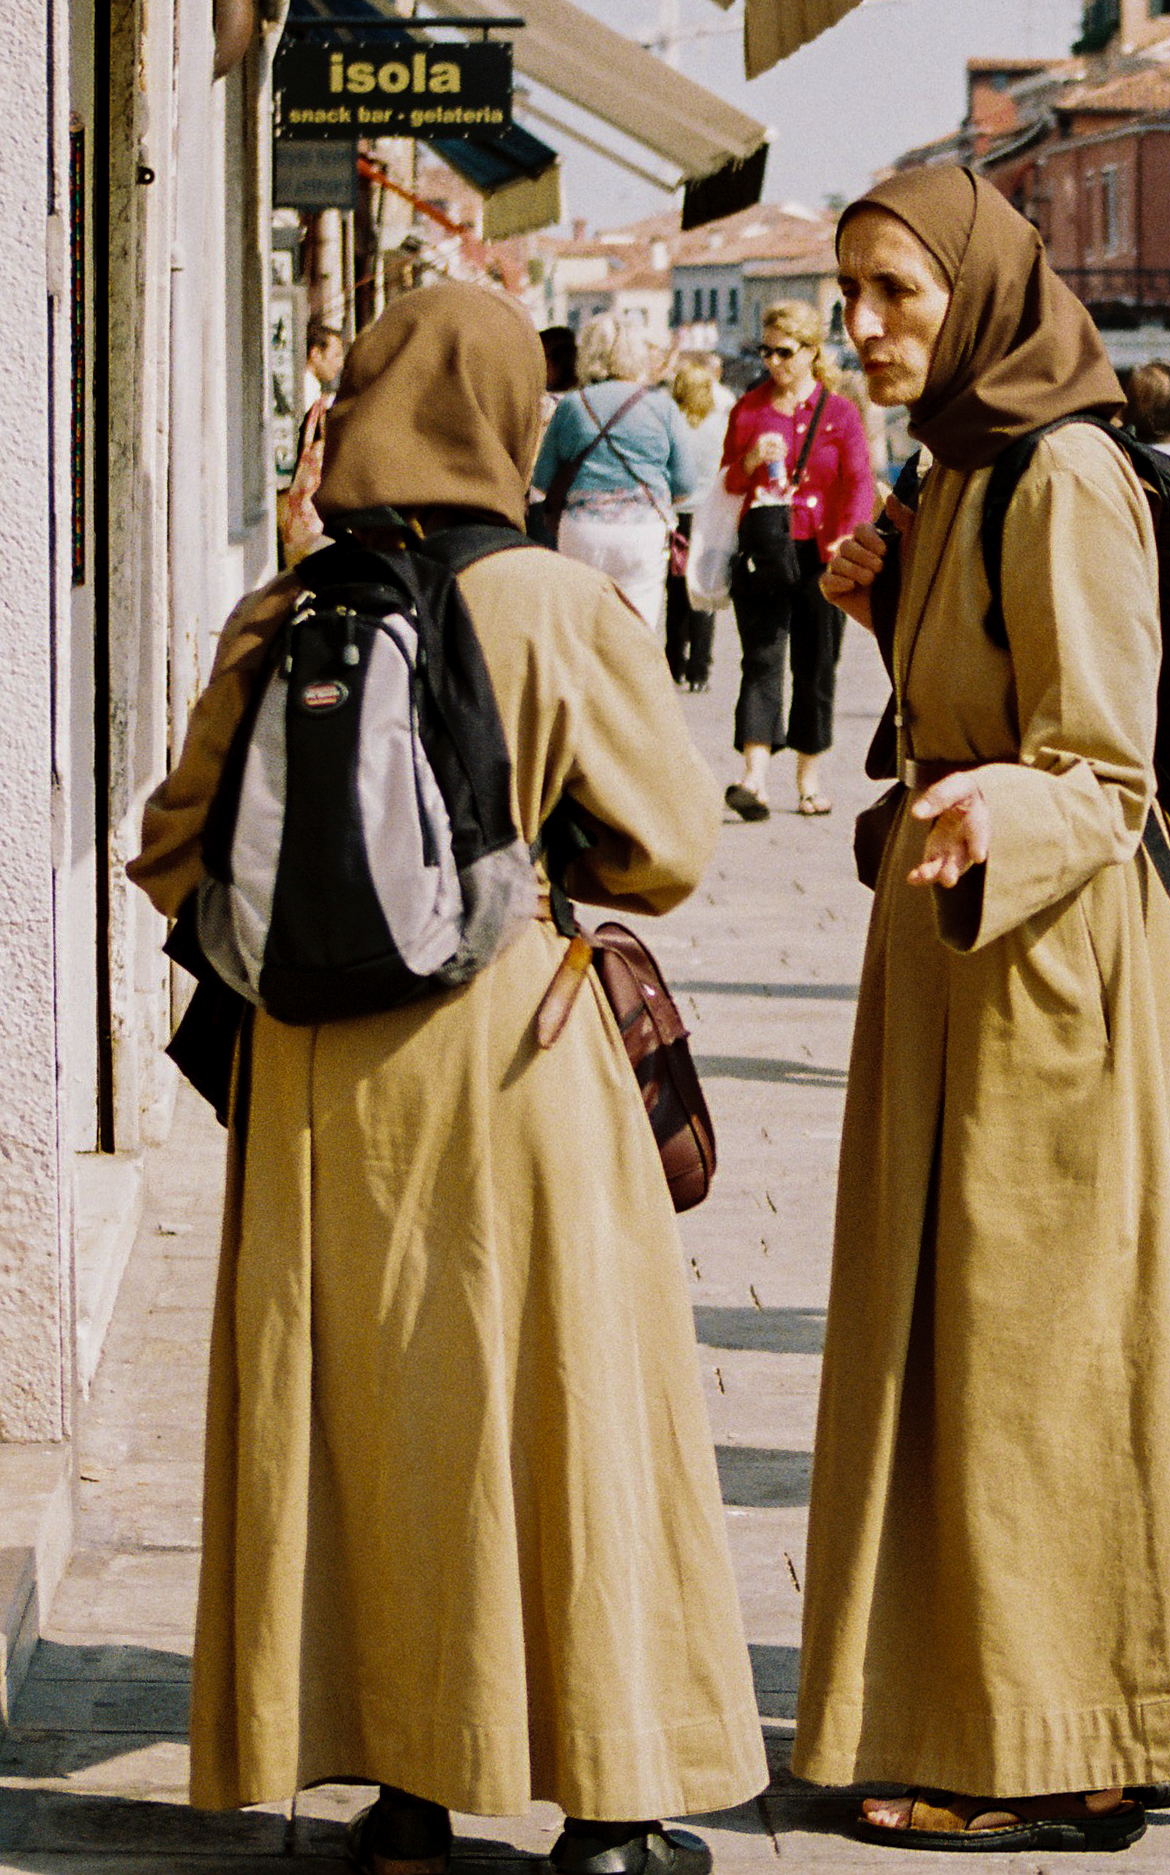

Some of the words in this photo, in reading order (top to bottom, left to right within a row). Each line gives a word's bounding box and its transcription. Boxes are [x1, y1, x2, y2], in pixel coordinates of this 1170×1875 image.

[329, 52, 461, 94] isola
[289, 106, 351, 124] snack
[357, 105, 393, 123] bar
[410, 106, 504, 128] gelateria
